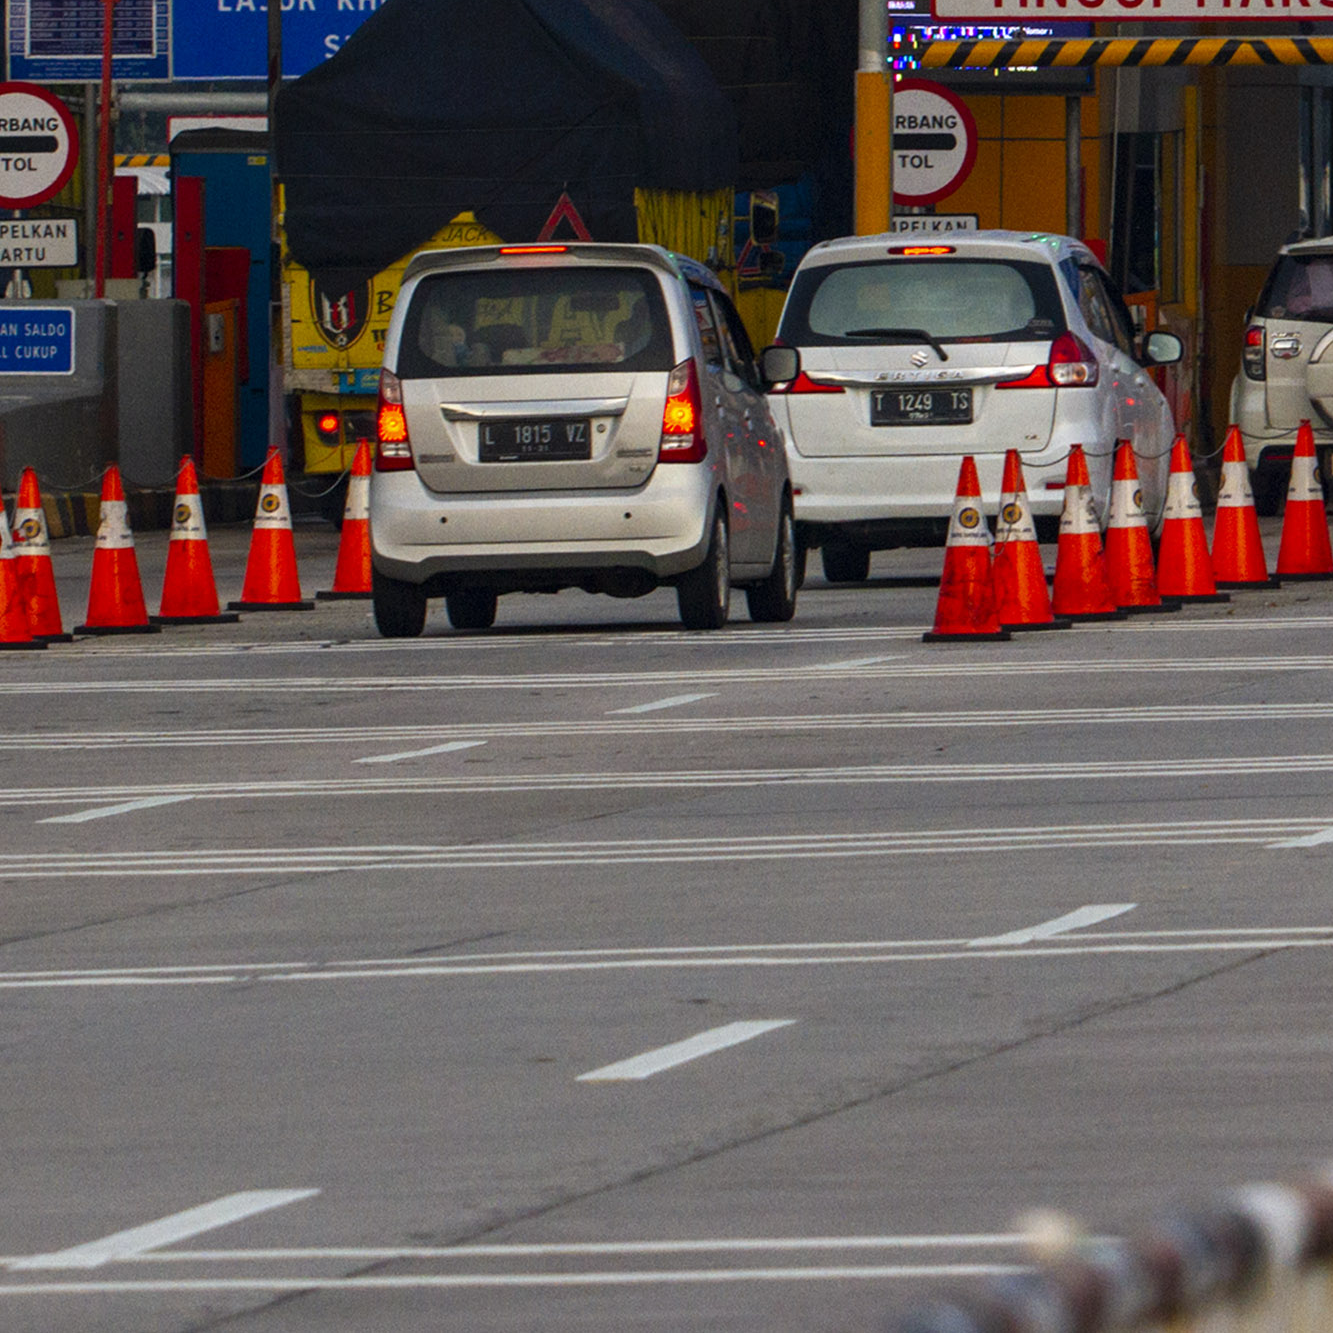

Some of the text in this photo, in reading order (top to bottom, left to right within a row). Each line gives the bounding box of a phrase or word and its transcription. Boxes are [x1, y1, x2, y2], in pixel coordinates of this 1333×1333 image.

[1, 157, 37, 171] TOL
[898, 154, 934, 168] TOL
[24, 323, 66, 337] SALDO
[15, 346, 57, 359] CUKUP
[875, 392, 968, 411] T 1249 TS
[485, 424, 586, 445] L 1815 VZ
